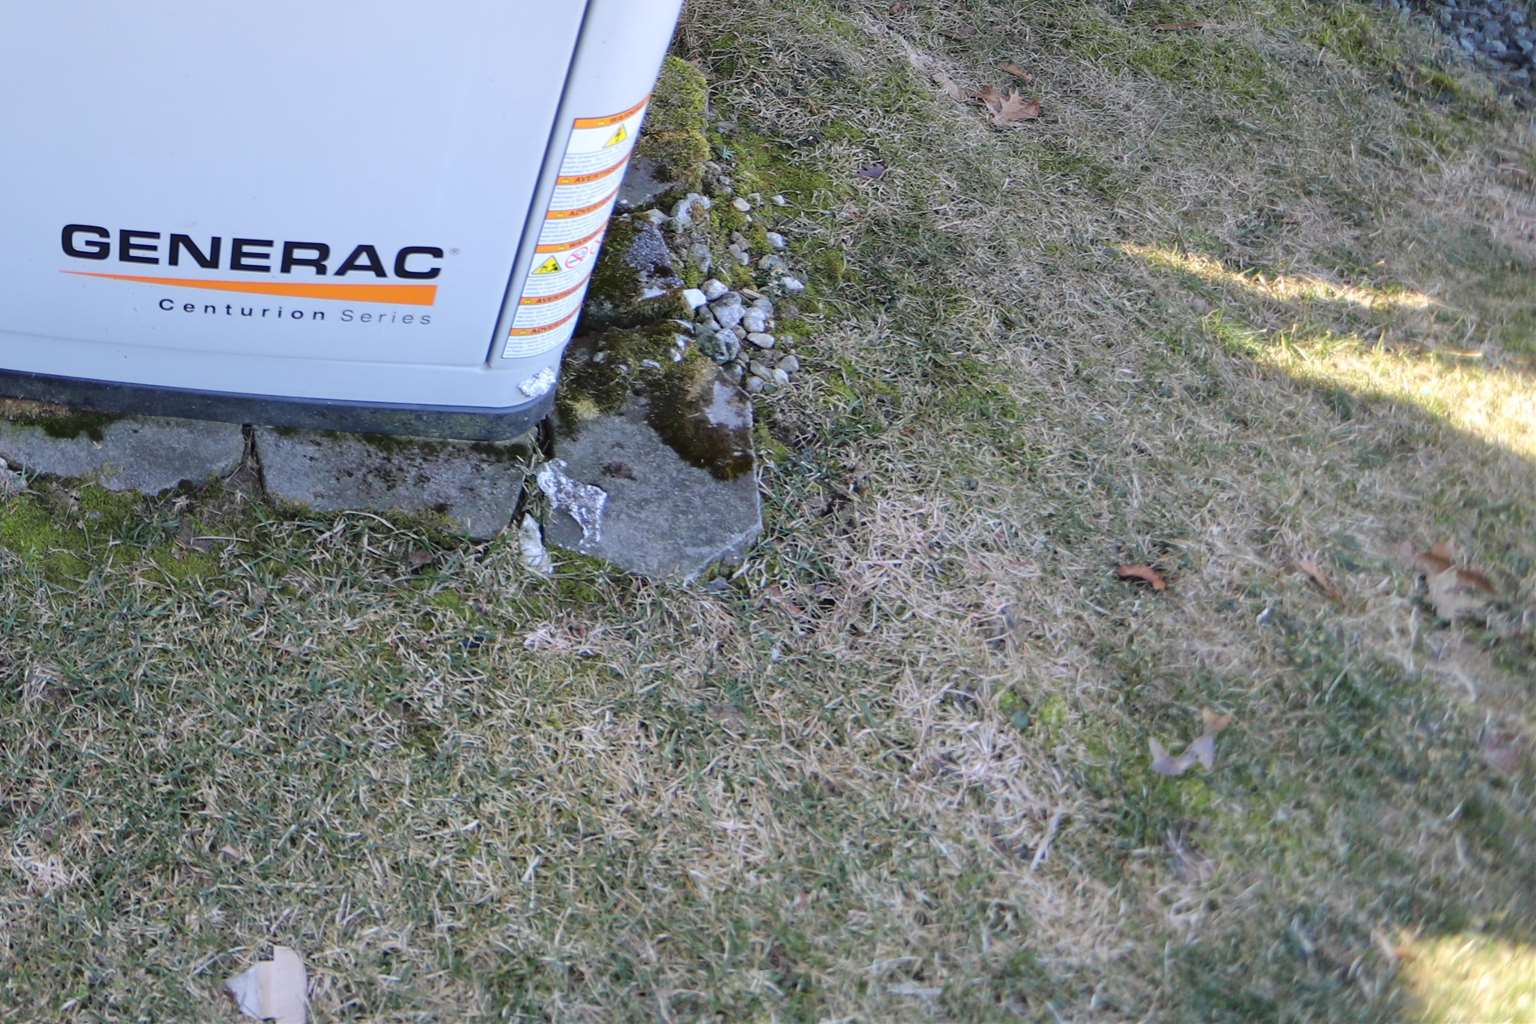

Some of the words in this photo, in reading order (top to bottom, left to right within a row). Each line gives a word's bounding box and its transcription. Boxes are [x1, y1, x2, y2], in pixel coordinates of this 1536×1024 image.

[61, 223, 443, 280] GENERAC
[158, 297, 326, 321] Centurion
[340, 308, 432, 326] Series
